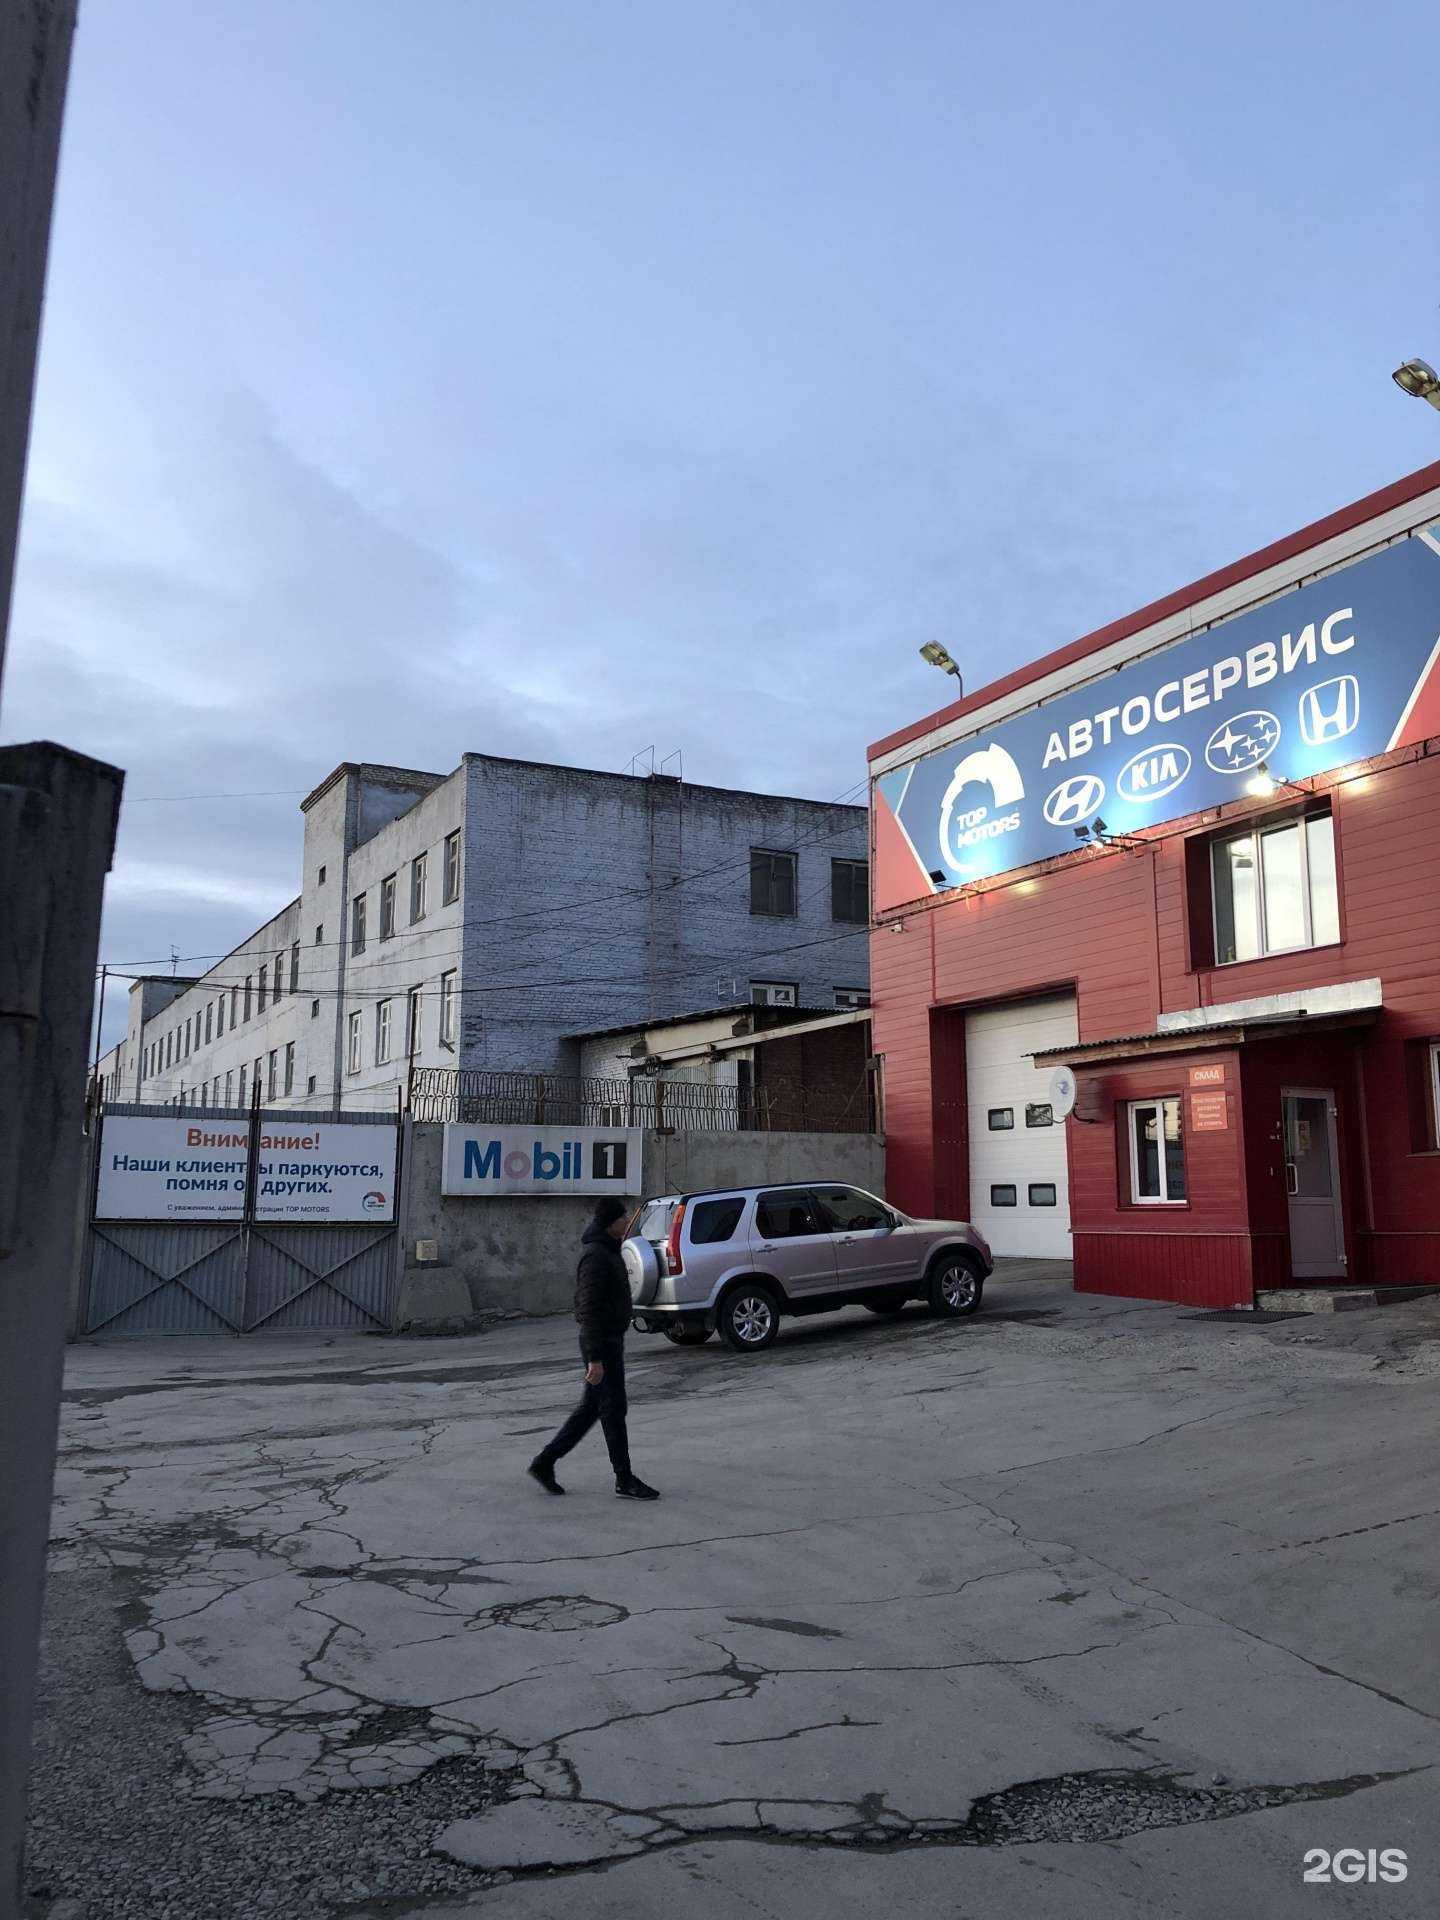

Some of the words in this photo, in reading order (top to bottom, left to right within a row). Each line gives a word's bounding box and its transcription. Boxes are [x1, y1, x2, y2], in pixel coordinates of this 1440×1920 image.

[1042, 607, 1355, 769] АВТОСЕРВИС
[1130, 751, 1179, 792] KIA
[956, 806, 988, 830] TOP
[957, 812, 1021, 849] MOTORS
[187, 1128, 320, 1150] Внимание!
[112, 1154, 170, 1172] Наши
[278, 1162, 384, 1179] паркуются,
[463, 1140, 582, 1181] Mobil
[602, 1144, 615, 1177] 1
[166, 1178, 228, 1192] помня
[260, 1180, 333, 1196] других.
